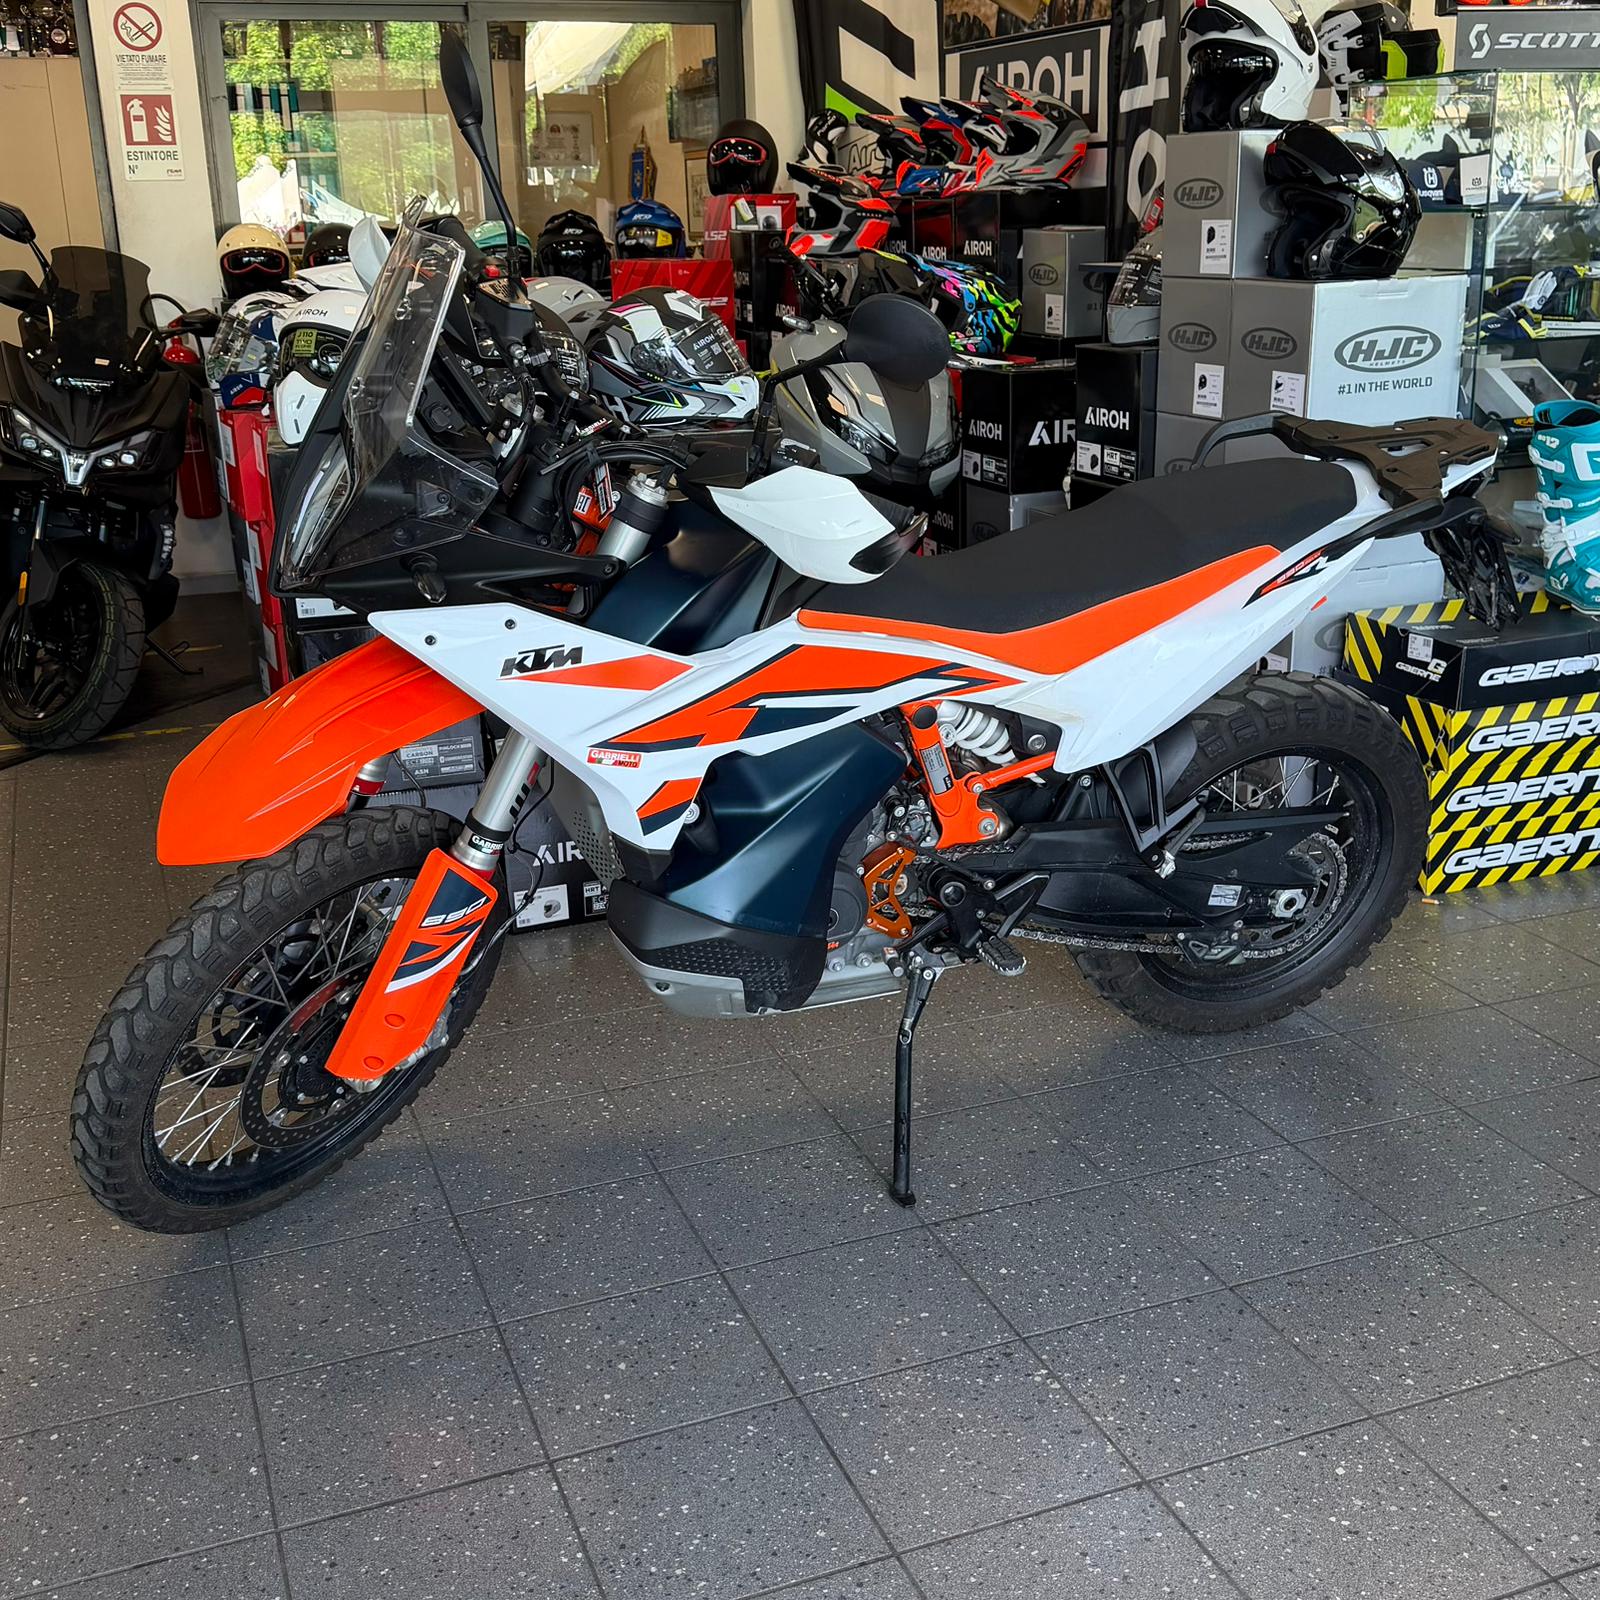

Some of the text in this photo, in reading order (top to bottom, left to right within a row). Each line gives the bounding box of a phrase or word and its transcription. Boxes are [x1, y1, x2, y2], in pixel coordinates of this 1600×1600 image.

[1495, 33, 1600, 48] SCOTT
[141, 55, 167, 63] FUMARE
[127, 151, 179, 161] ESTINTORE
[1181, 186, 1217, 201] HJC
[704, 230, 728, 240] LS2
[922, 246, 947, 260] AIROH
[963, 240, 993, 256] AIROH
[297, 308, 328, 317] AIROH
[692, 334, 715, 351] AIROH
[1174, 329, 1210, 346] HJC
[1248, 334, 1290, 353] HJC
[1347, 335, 1429, 363] HJC
[1337, 376, 1433, 395] #1 IN THE WORLD
[1085, 406, 1130, 431] AIROH
[968, 419, 1003, 441] AIROH
[500, 644, 583, 677] KTM
[591, 750, 639, 761] GABRIELLI
[617, 760, 638, 768] MOTO
[421, 896, 487, 927] 890
